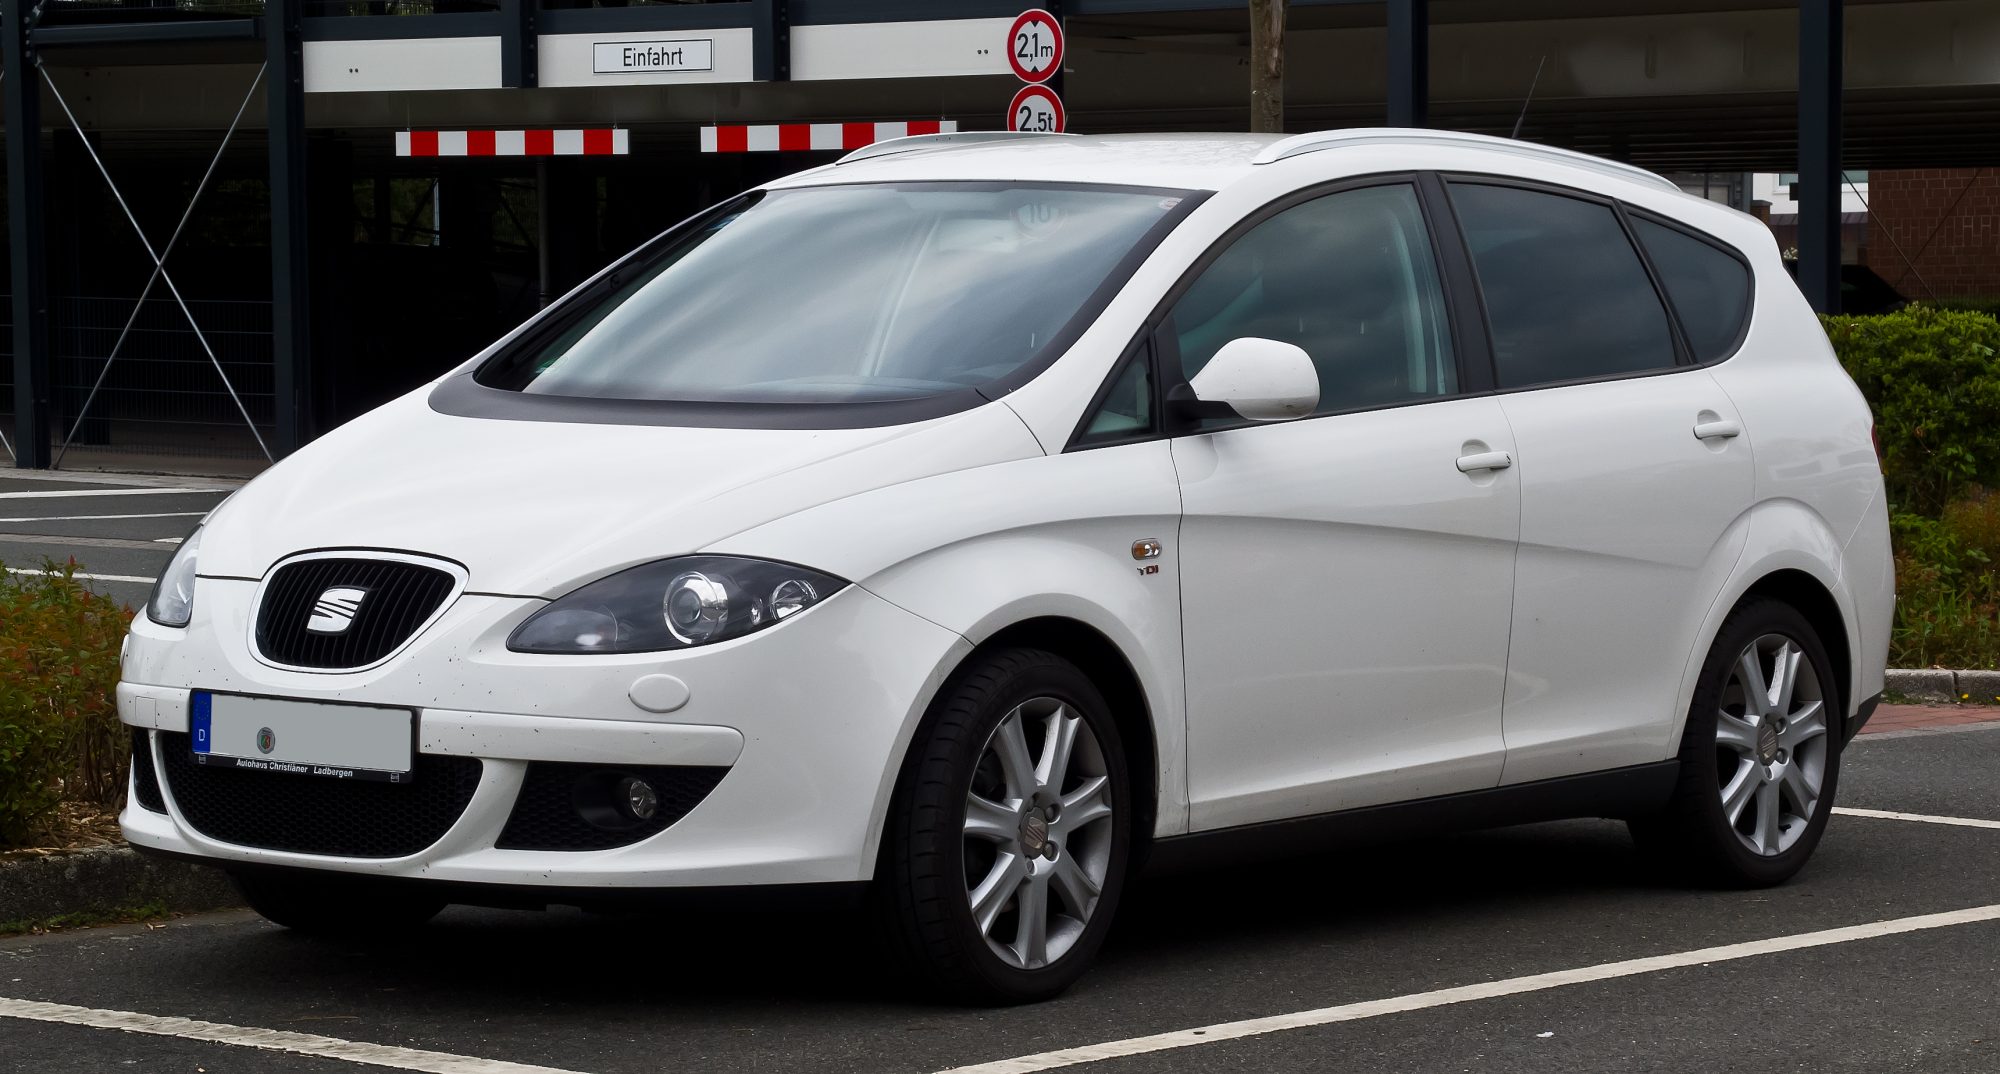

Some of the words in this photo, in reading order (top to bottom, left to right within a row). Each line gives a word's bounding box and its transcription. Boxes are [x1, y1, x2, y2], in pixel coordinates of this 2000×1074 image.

[623, 46, 683, 67] Einfahrt
[1017, 32, 1054, 62] 2,1m
[1137, 565, 1159, 576] TDI
[198, 729, 206, 741] D
[236, 759, 268, 769] Autohaus
[313, 766, 353, 778] Ladbergen
